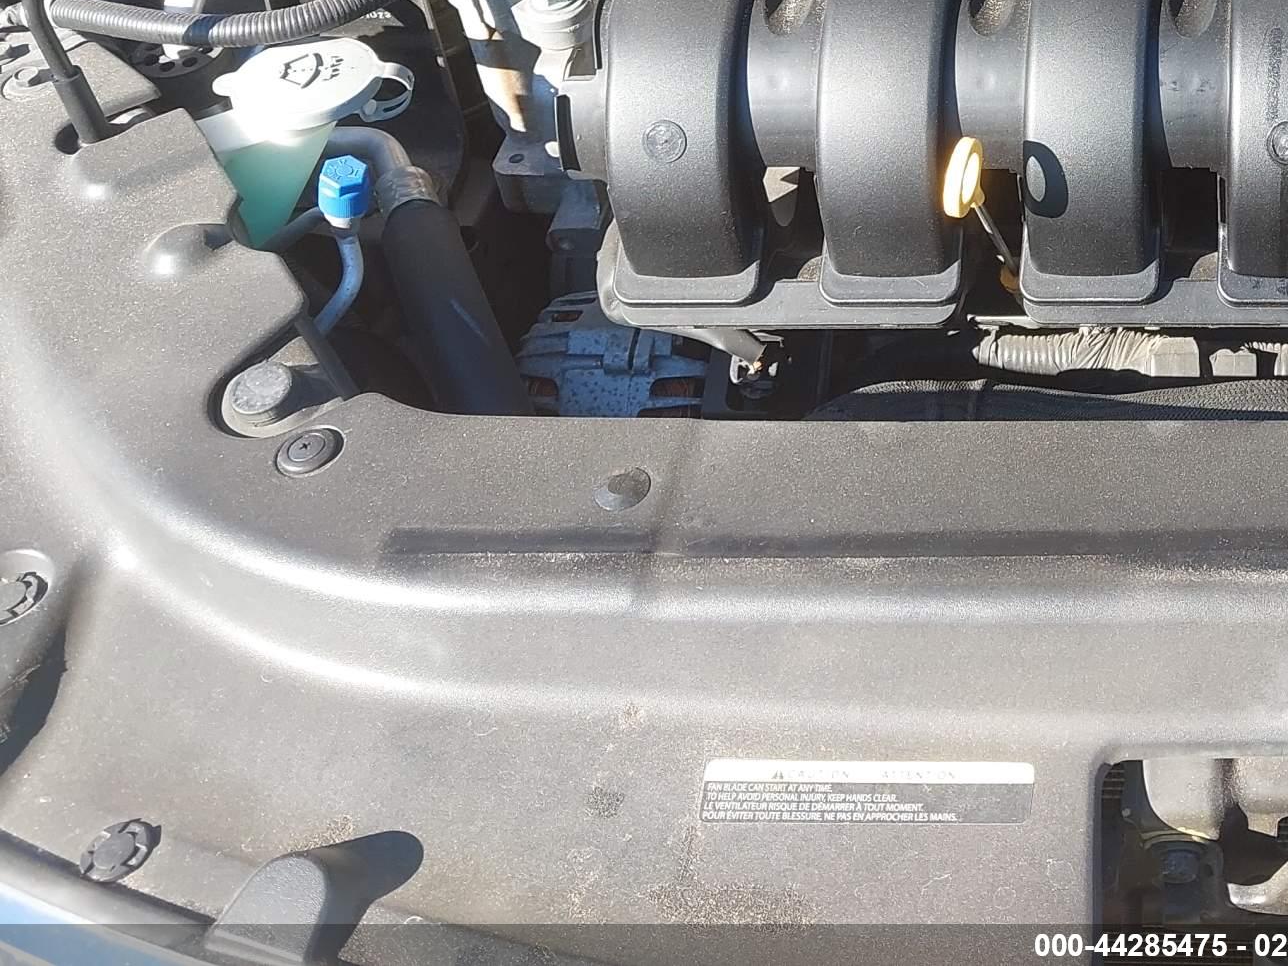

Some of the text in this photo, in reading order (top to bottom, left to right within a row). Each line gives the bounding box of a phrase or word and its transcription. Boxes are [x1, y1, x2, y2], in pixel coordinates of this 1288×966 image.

[787, 770, 849, 779] CAUTON
[882, 771, 955, 779] ATTENTON
[707, 783, 722, 791] FAN
[723, 783, 747, 791] BLADE
[748, 783, 764, 791] CAN
[765, 783, 786, 792] START
[787, 784, 798, 792] AT
[798, 784, 815, 792] ANY
[706, 792, 716, 800] TO
[718, 792, 736, 801] HELP
[737, 793, 760, 801] AVOID
[761, 793, 799, 801] PERSONAL
[827, 794, 845, 802] KEEP
[846, 794, 872, 802] HANDS
[704, 802, 714, 810] LE
[715, 802, 767, 811] VENTILATEUR
[768, 802, 798, 811] RISQUE
[799, 803, 810, 811] DE
[811, 802, 855, 811] DÉMARRER
[863, 803, 885, 811] TOUT
[703, 811, 725, 820] POUR
[727, 809, 753, 820] ÉVITER
[754, 811, 781, 820] TOUTE
[824, 812, 835, 821] NE
[836, 812, 852, 821] PAS
[853, 812, 864, 821] EN
[864, 813, 913, 821] APPROCHER
[915, 813, 929, 821] LES
